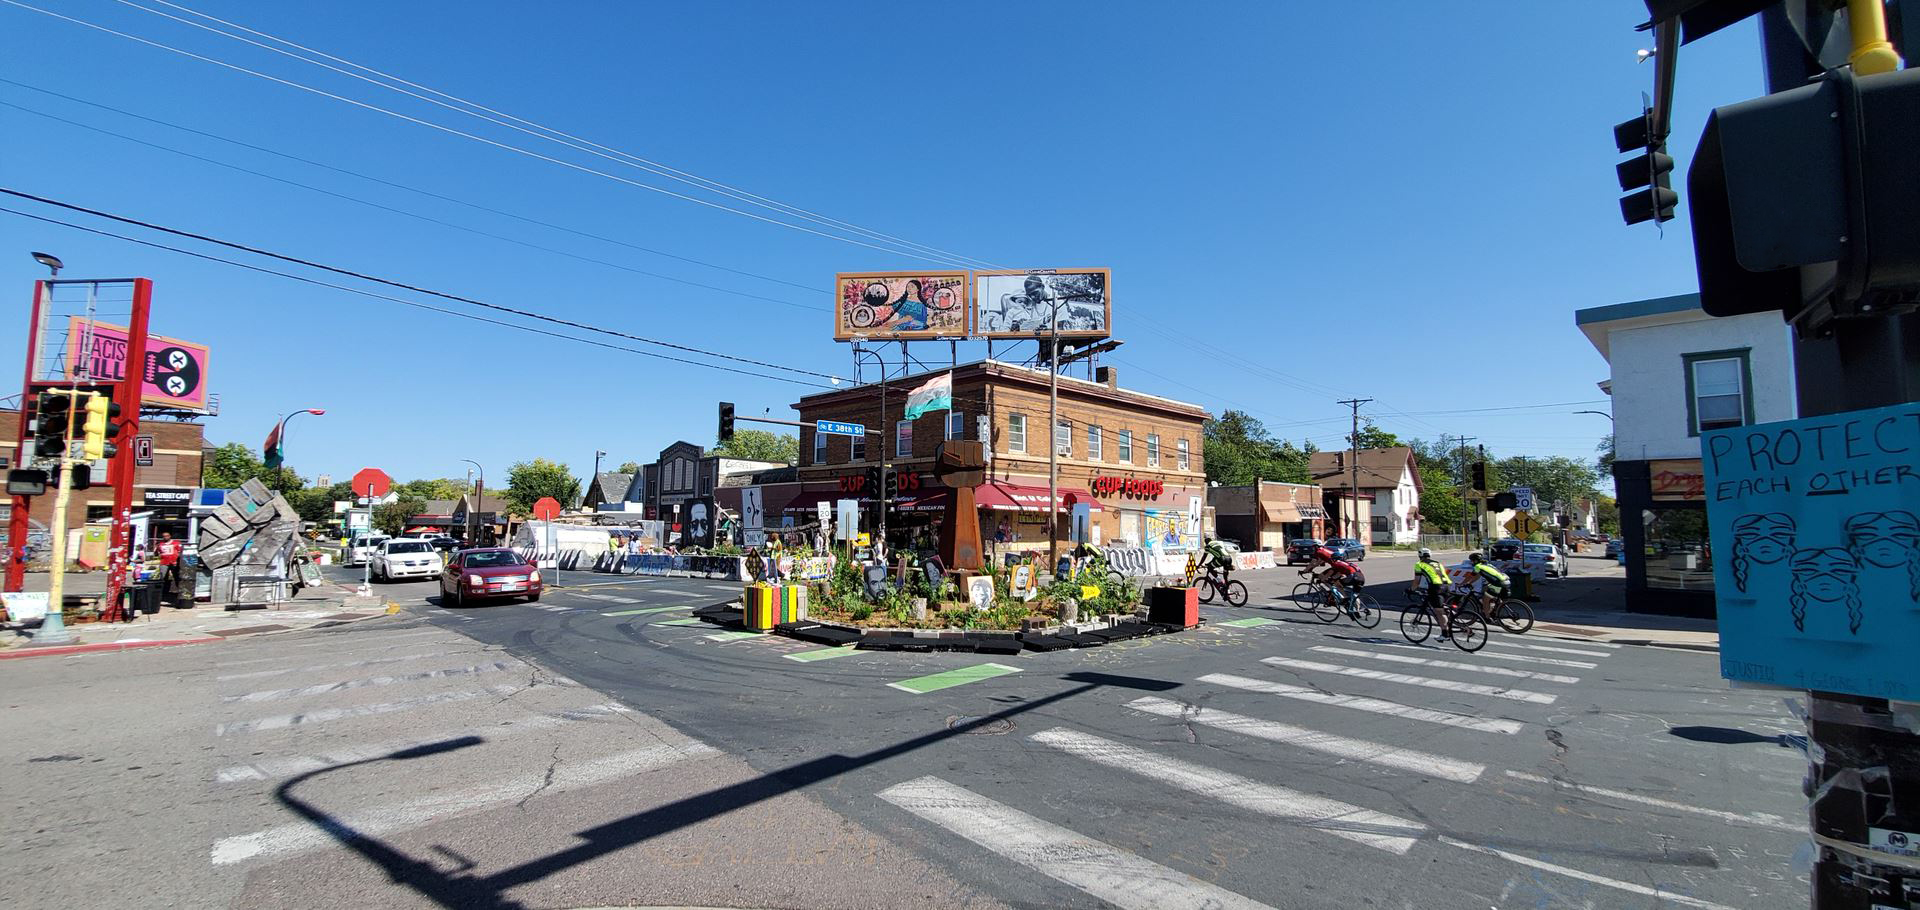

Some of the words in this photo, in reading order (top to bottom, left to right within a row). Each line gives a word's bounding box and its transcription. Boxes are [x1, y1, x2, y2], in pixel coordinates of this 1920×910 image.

[835, 424, 853, 433] 38th
[854, 426, 863, 434] St
[839, 475, 865, 492] CUP
[1096, 476, 1121, 492] CUP
[1125, 478, 1164, 495] FOODS
[1716, 475, 1791, 500] EACH
[1808, 464, 1920, 492] OTHER
